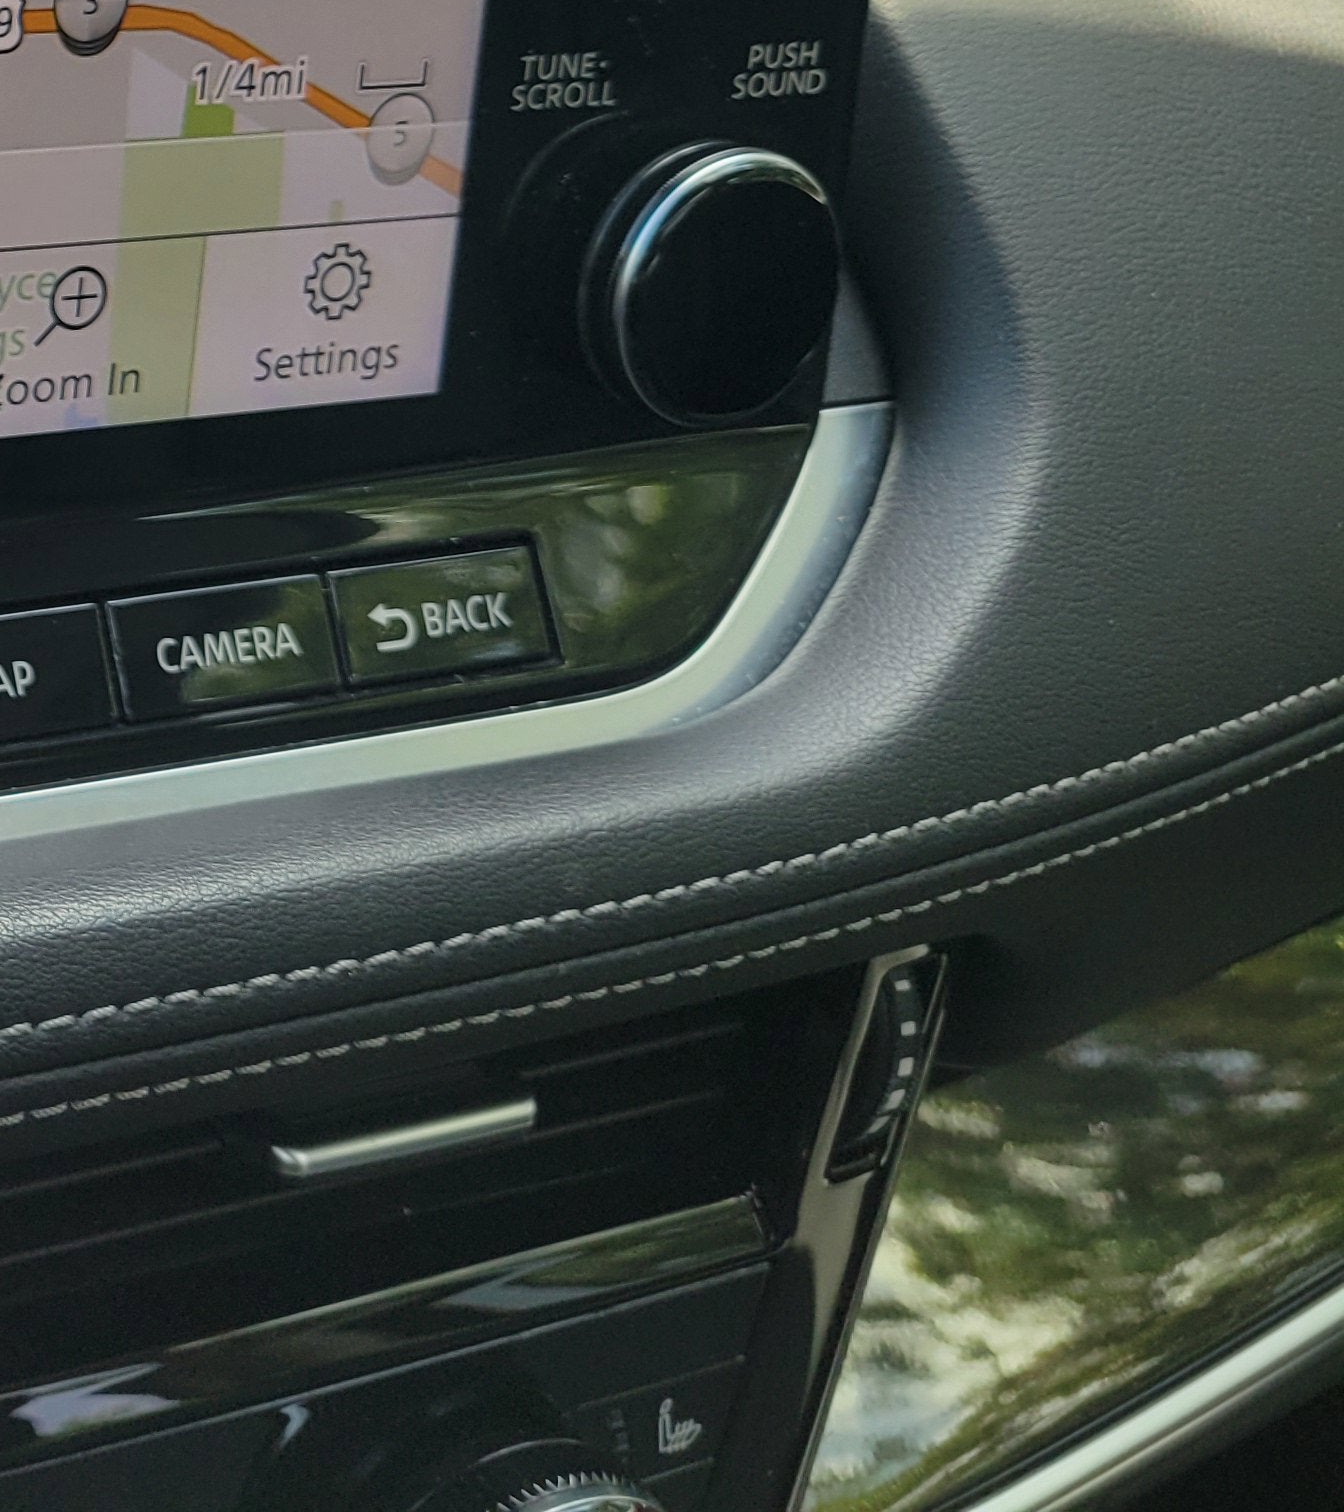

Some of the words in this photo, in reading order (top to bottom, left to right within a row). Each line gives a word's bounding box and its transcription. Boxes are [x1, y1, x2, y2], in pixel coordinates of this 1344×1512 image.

[747, 41, 820, 69] PUSH
[194, 59, 307, 101] 1/4mi
[511, 80, 616, 112] SCROLL
[731, 68, 826, 100] SOUND
[107, 363, 141, 396] In
[254, 342, 400, 382] Settings
[423, 592, 512, 638] BACK
[155, 622, 301, 676] CAMERA
